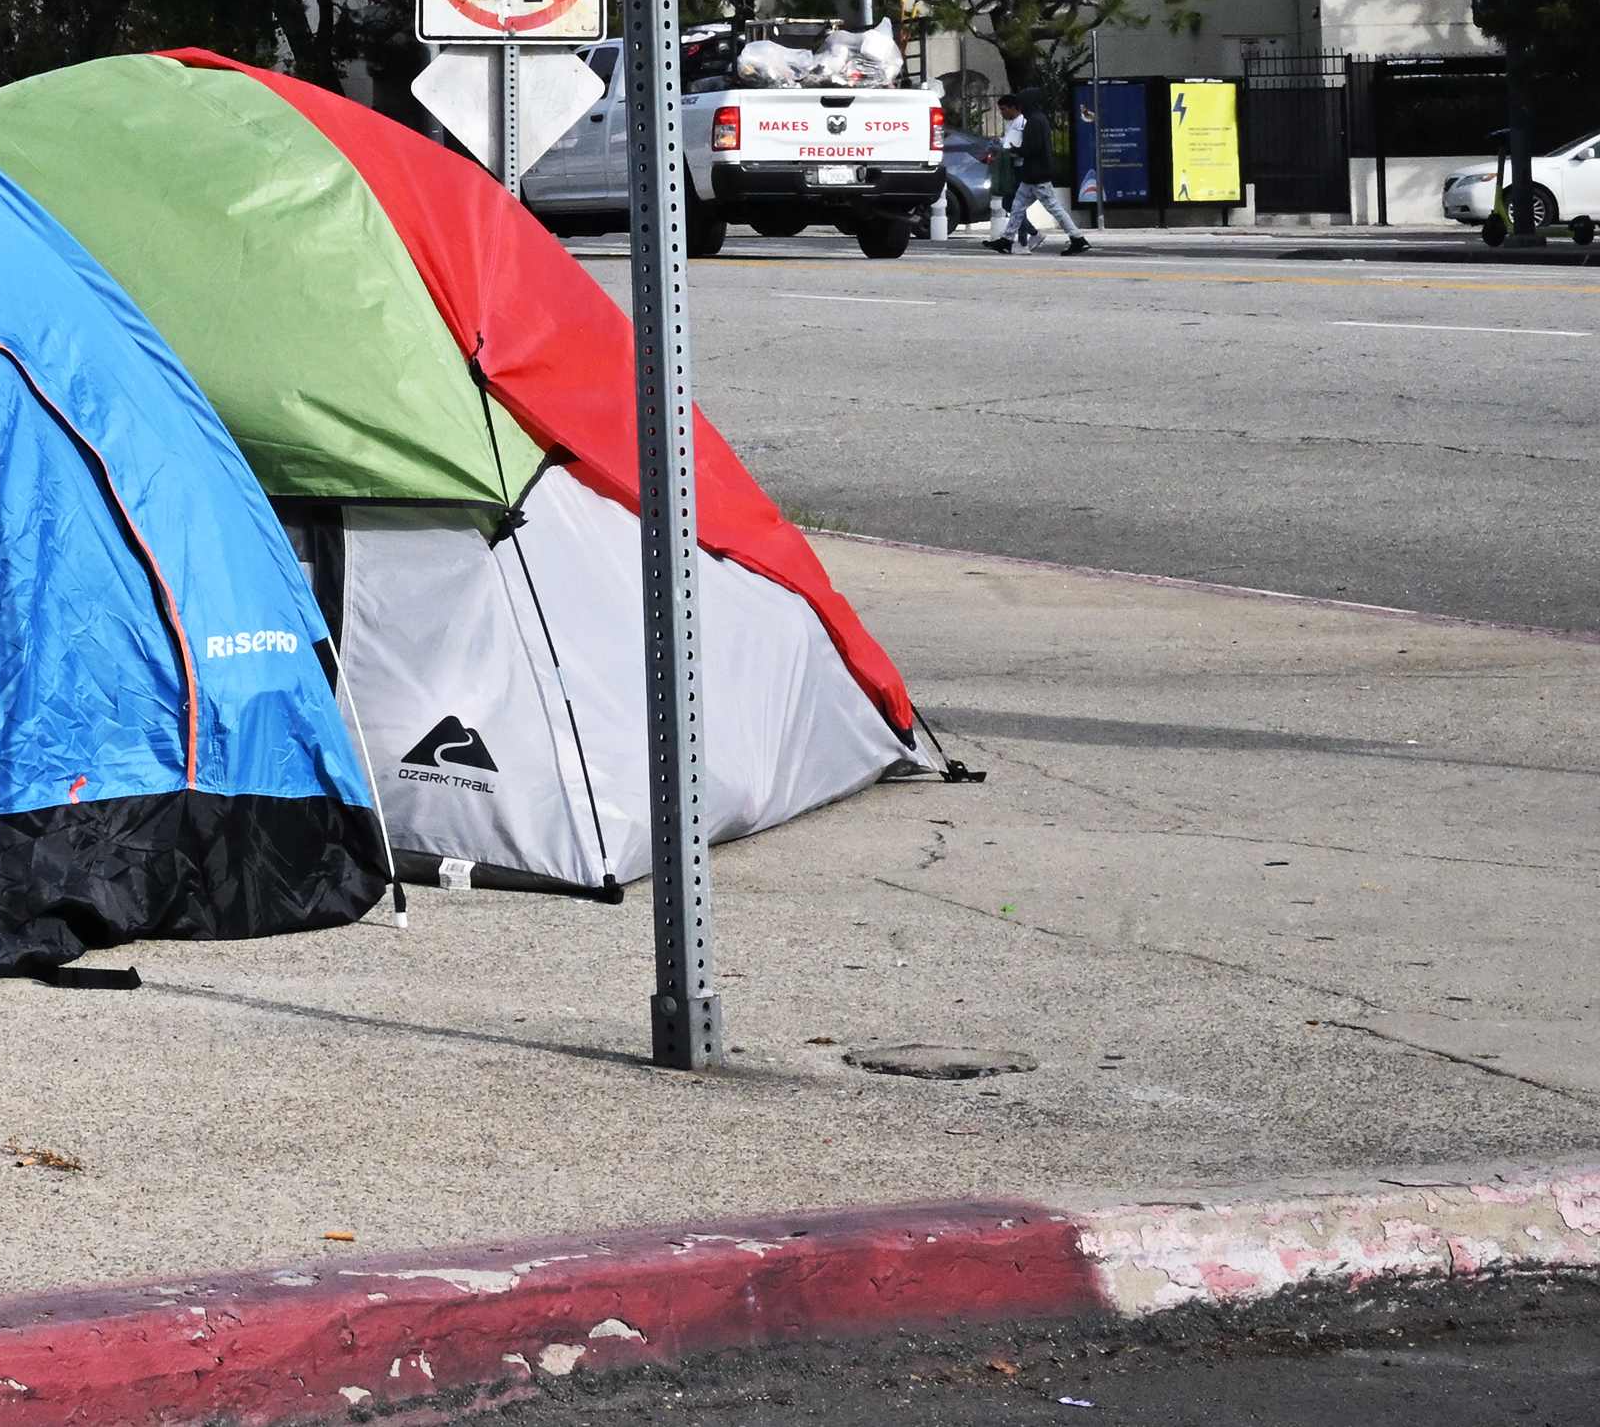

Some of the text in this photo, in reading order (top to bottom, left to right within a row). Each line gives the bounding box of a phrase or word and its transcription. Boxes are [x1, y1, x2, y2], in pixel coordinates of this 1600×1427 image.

[759, 121, 910, 132] MAKES STOPS
[799, 147, 875, 157] FREQUENT
